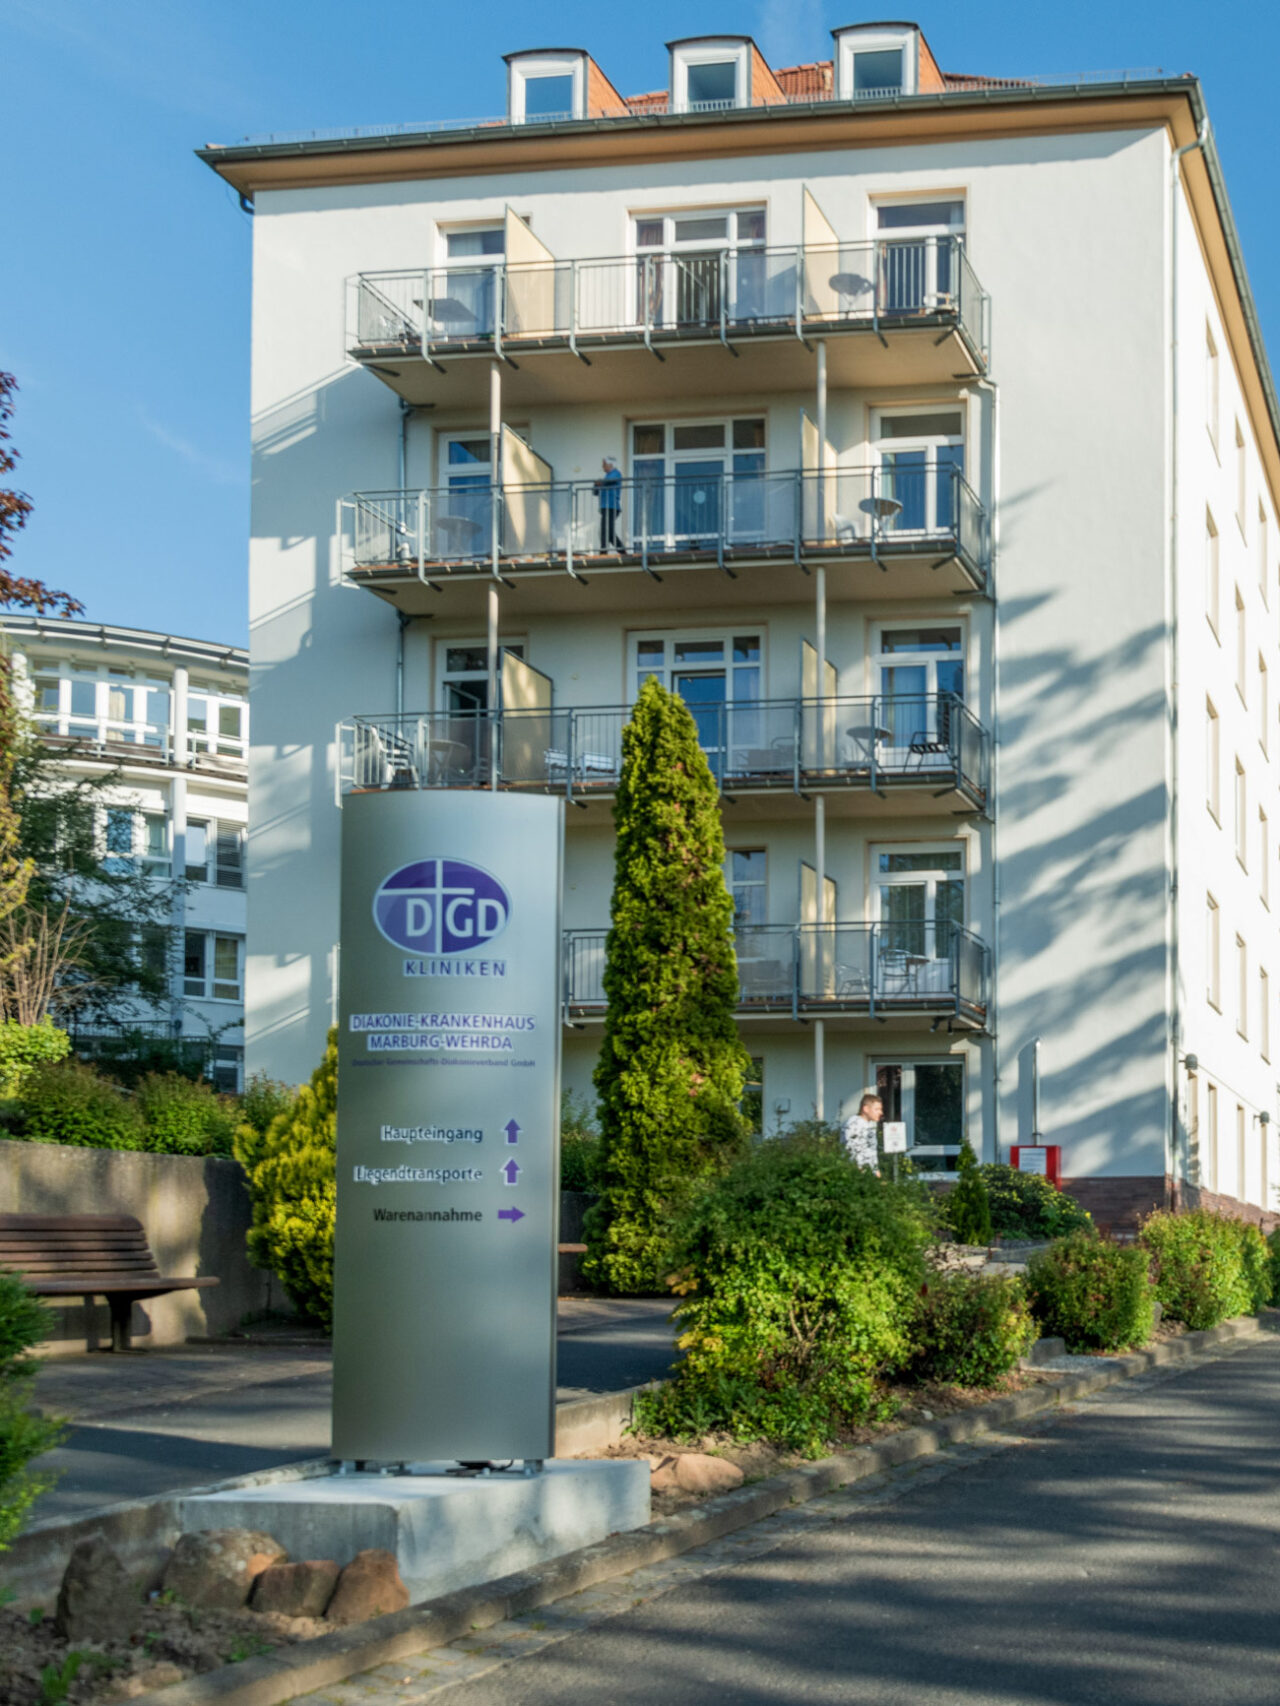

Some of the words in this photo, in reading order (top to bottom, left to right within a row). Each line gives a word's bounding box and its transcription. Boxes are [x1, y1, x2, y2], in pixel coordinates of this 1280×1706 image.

[405, 897, 506, 938] DGD
[405, 960, 506, 977] KLINIKEN
[352, 1013, 536, 1031] DIAKONIE-KRANKENHAUS
[370, 1034, 513, 1050] MARBURG-WEHRDA
[383, 1125, 483, 1143] Haupteingang
[356, 1165, 483, 1183] Liegendtransporte
[373, 1208, 483, 1222] Warenannahme
